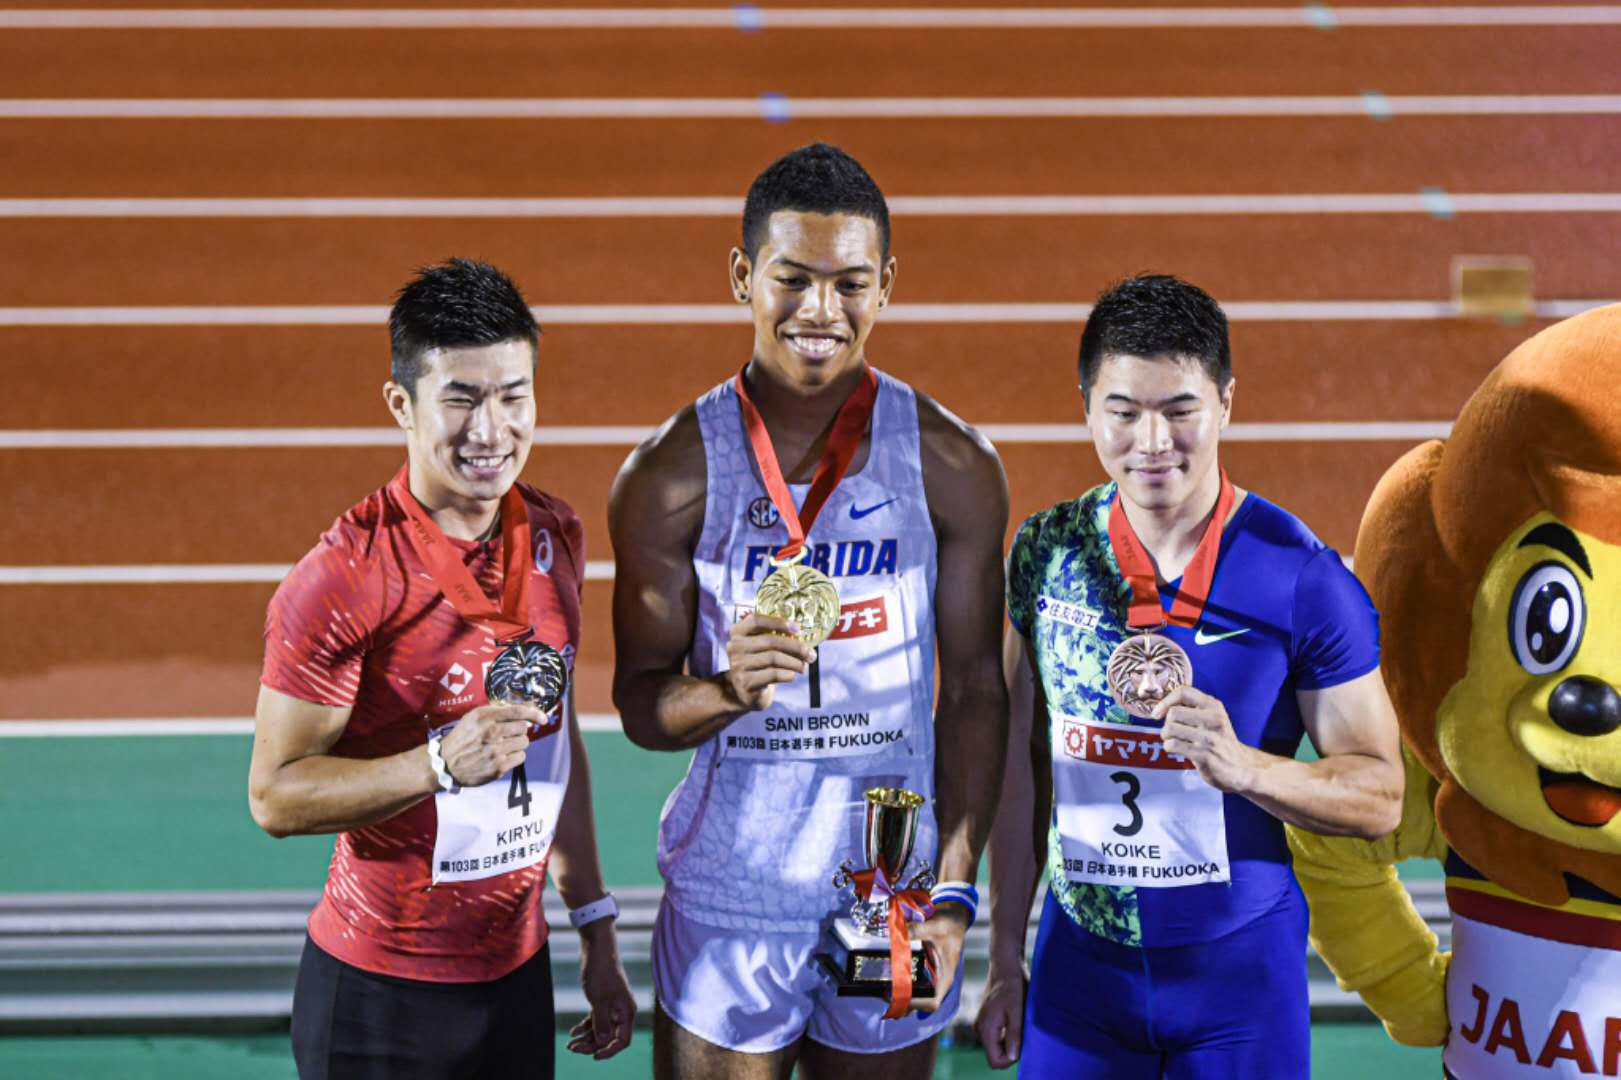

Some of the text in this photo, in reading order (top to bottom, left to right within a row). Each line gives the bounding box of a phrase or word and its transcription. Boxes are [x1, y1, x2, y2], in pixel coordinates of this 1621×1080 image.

[751, 498, 778, 527] SEC
[765, 712, 870, 732] SANI BROWN
[769, 736, 824, 752] 日本選手権
[828, 729, 904, 749] FUKUOKA
[508, 762, 532, 817] 4
[1109, 771, 1143, 837] 3
[496, 819, 544, 846] KIRYU
[483, 846, 526, 869] 日本選手権
[1101, 842, 1161, 859] KOIKE
[1087, 860, 1138, 878] 日本選手権
[1142, 862, 1220, 879] FUKUOKA
